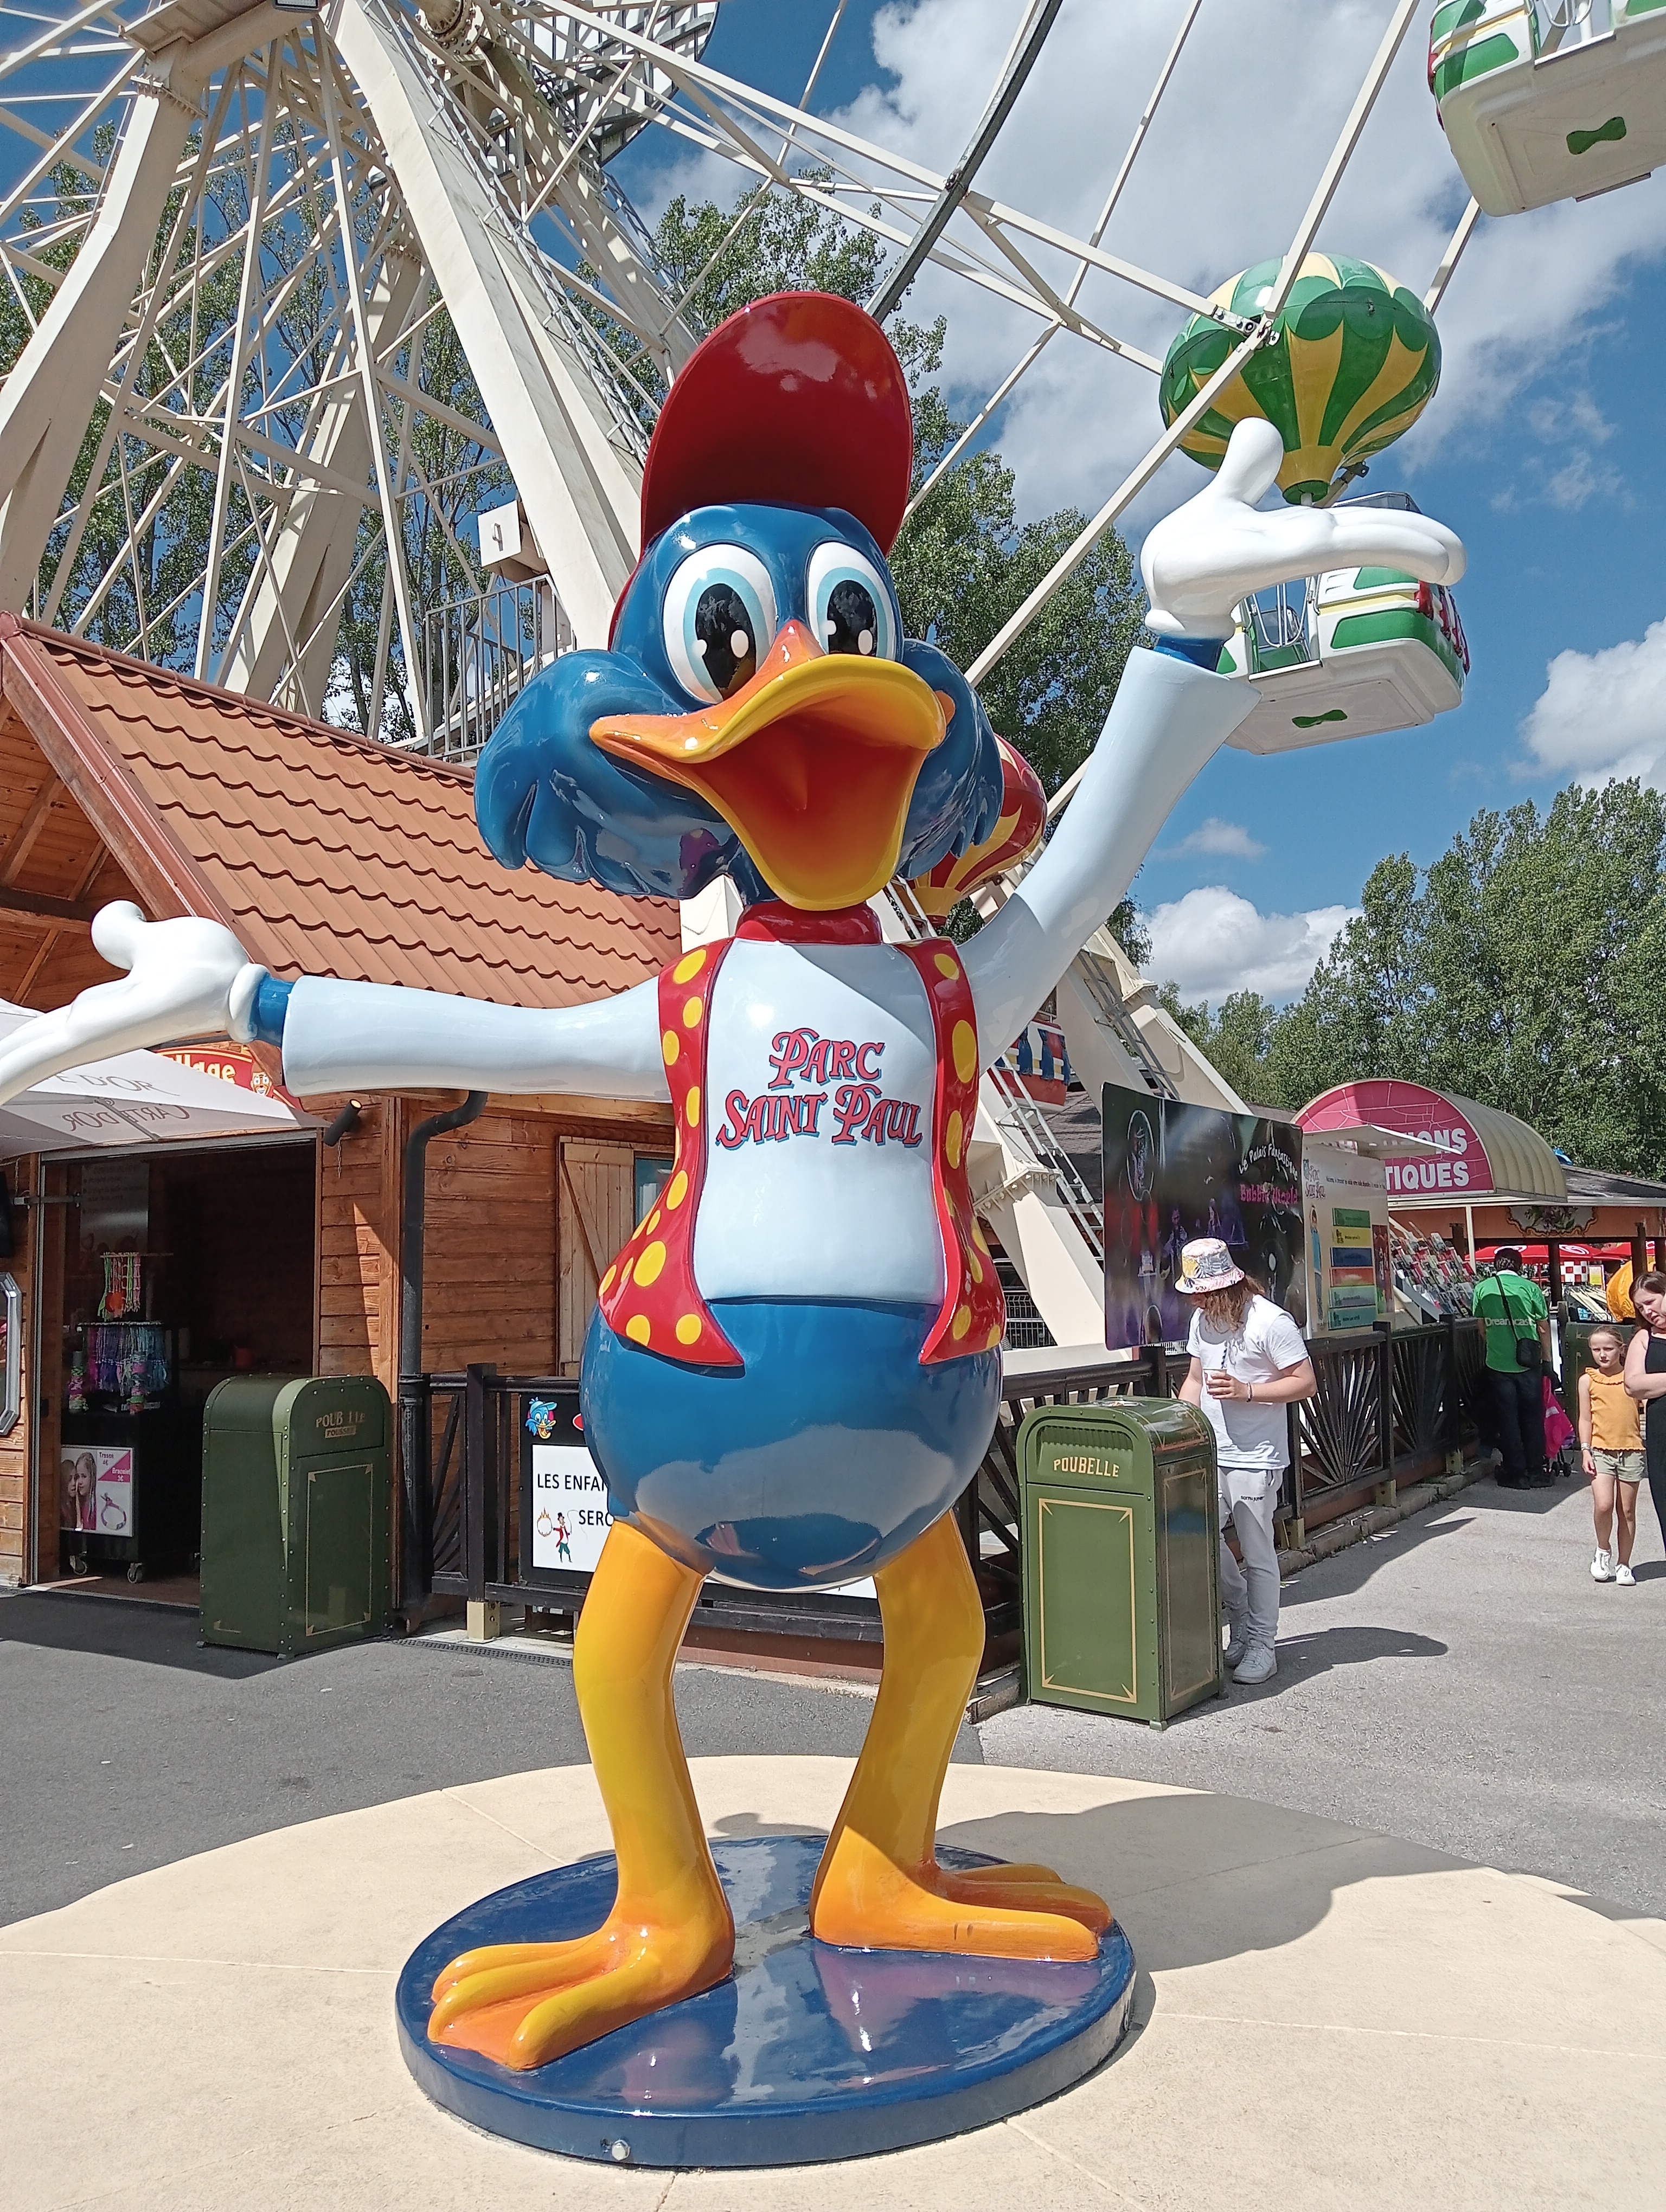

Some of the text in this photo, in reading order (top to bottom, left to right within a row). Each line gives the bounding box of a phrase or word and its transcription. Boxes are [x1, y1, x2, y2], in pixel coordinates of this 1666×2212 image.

[768, 1027, 885, 1091] PARC
[715, 1083, 922, 1150] SAINT PAUL
[1238, 1159, 1248, 1174] Le
[1249, 1145, 1267, 1163] Palais
[537, 1473, 560, 1489] LES
[1053, 1456, 1120, 1477] POUBELLE
